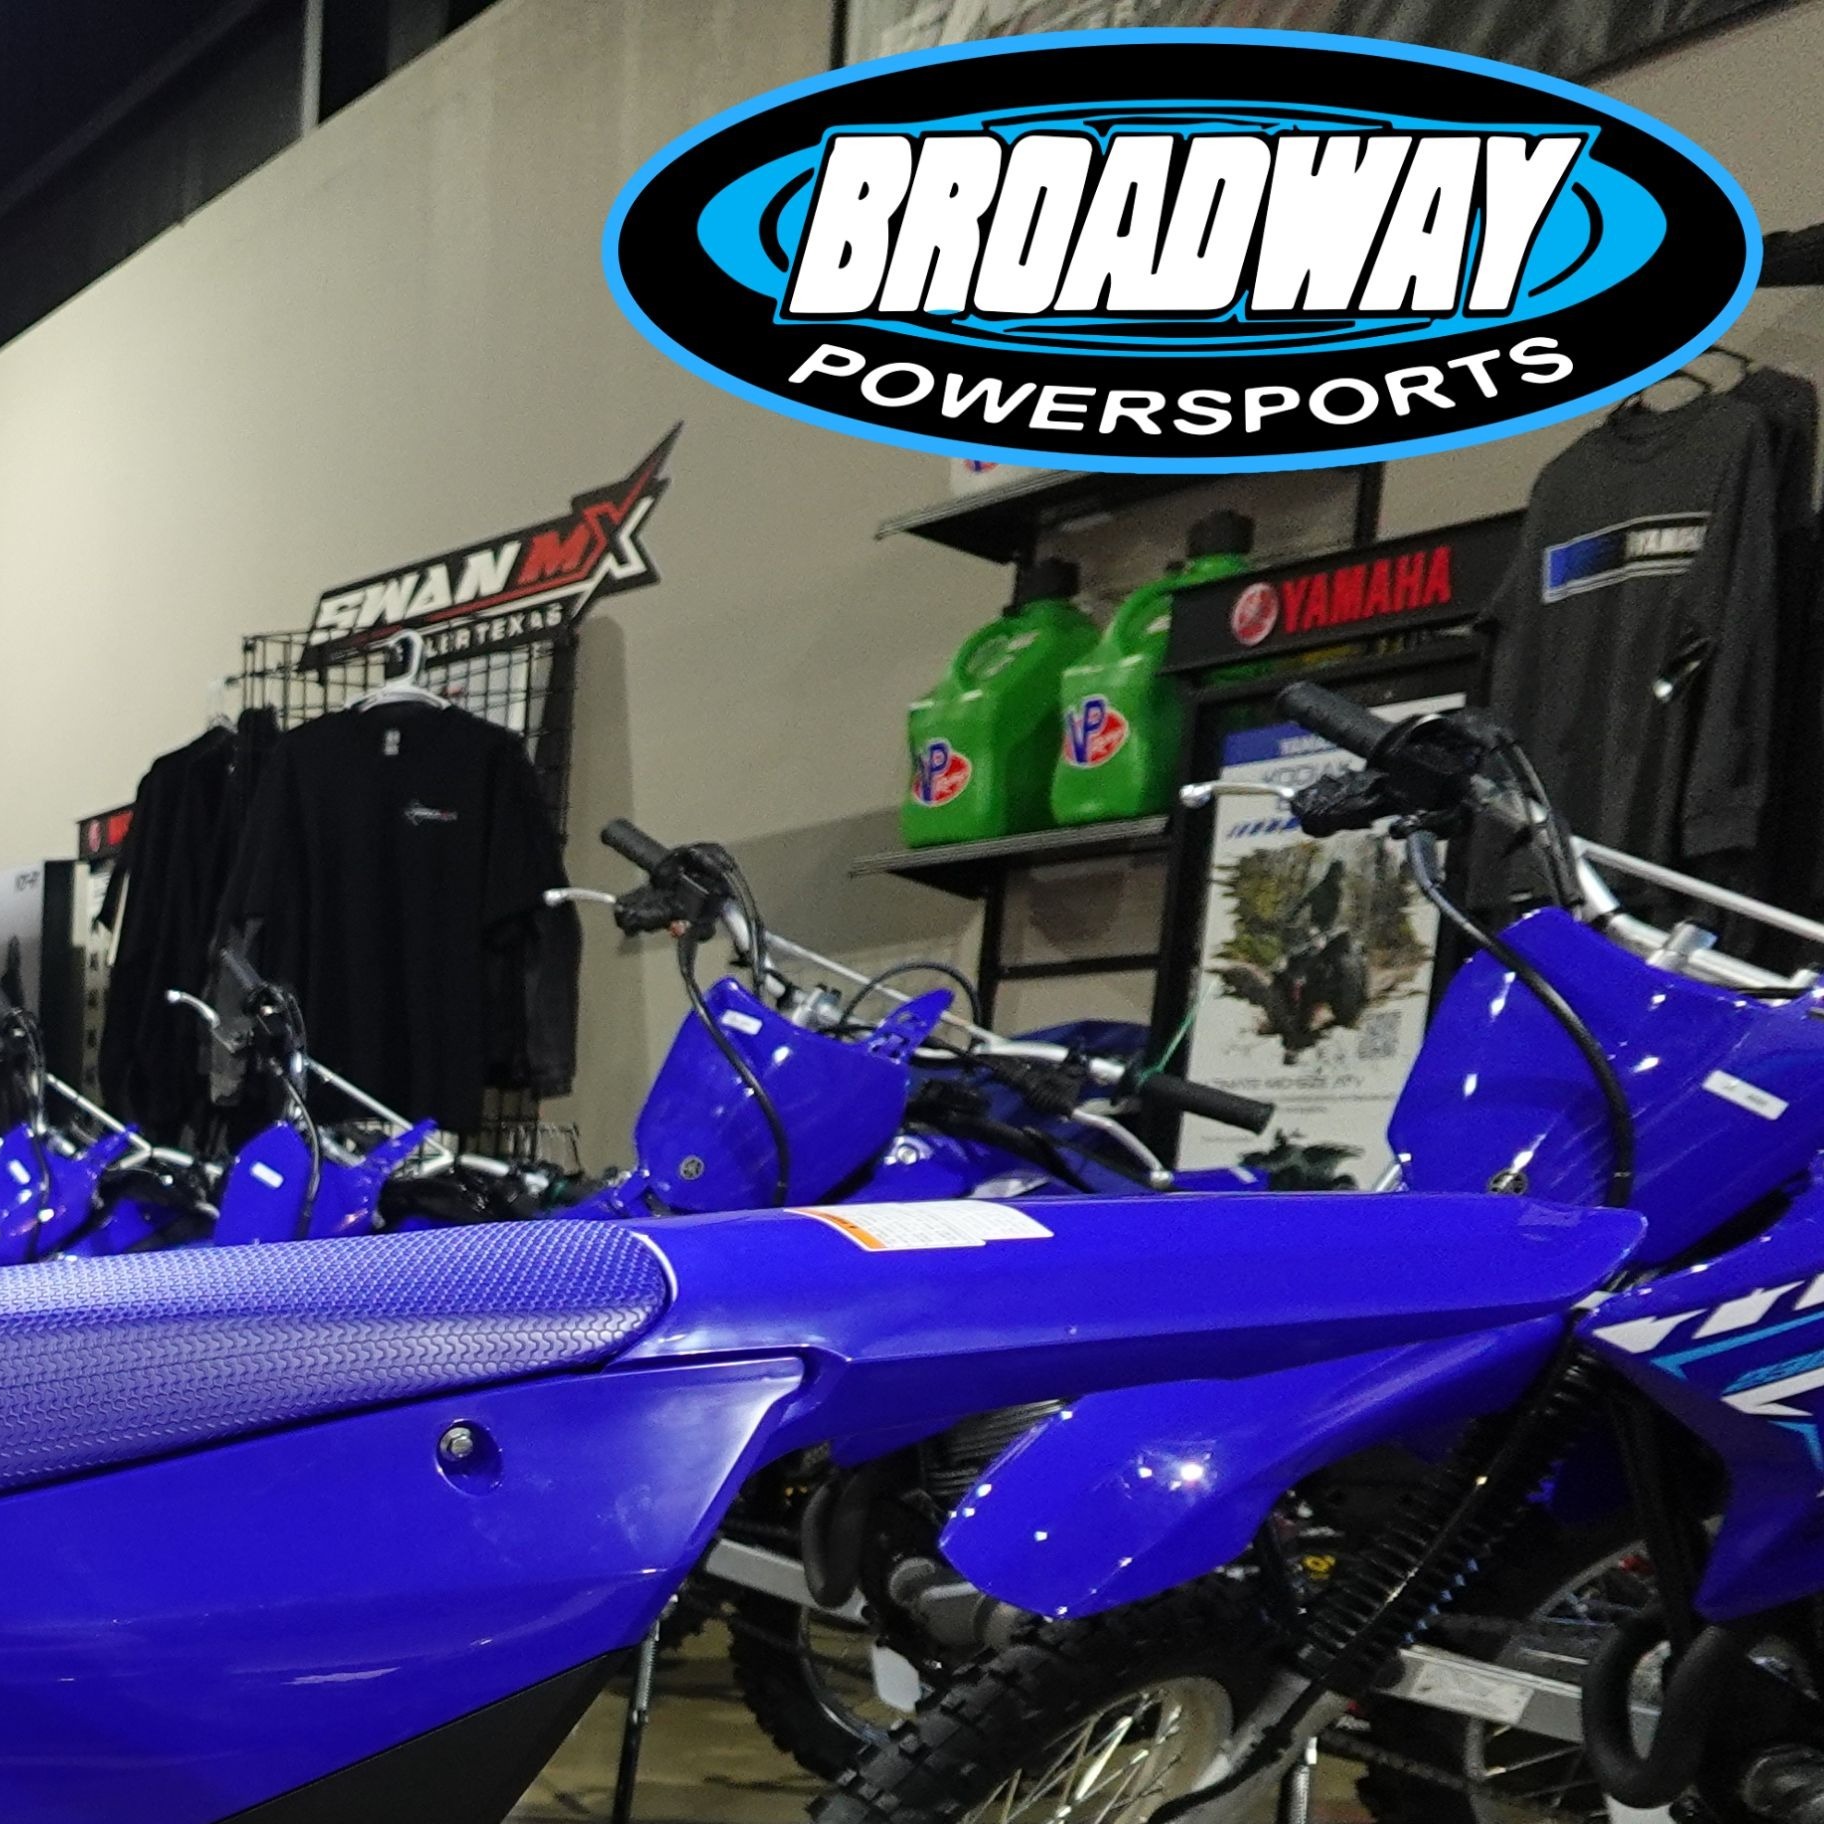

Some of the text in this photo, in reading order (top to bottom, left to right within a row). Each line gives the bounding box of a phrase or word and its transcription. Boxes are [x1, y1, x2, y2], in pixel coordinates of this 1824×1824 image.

[309, 480, 654, 646] SWAN MX
[1282, 546, 1451, 634] YAMAHA
[475, 603, 564, 645] TEXAS
